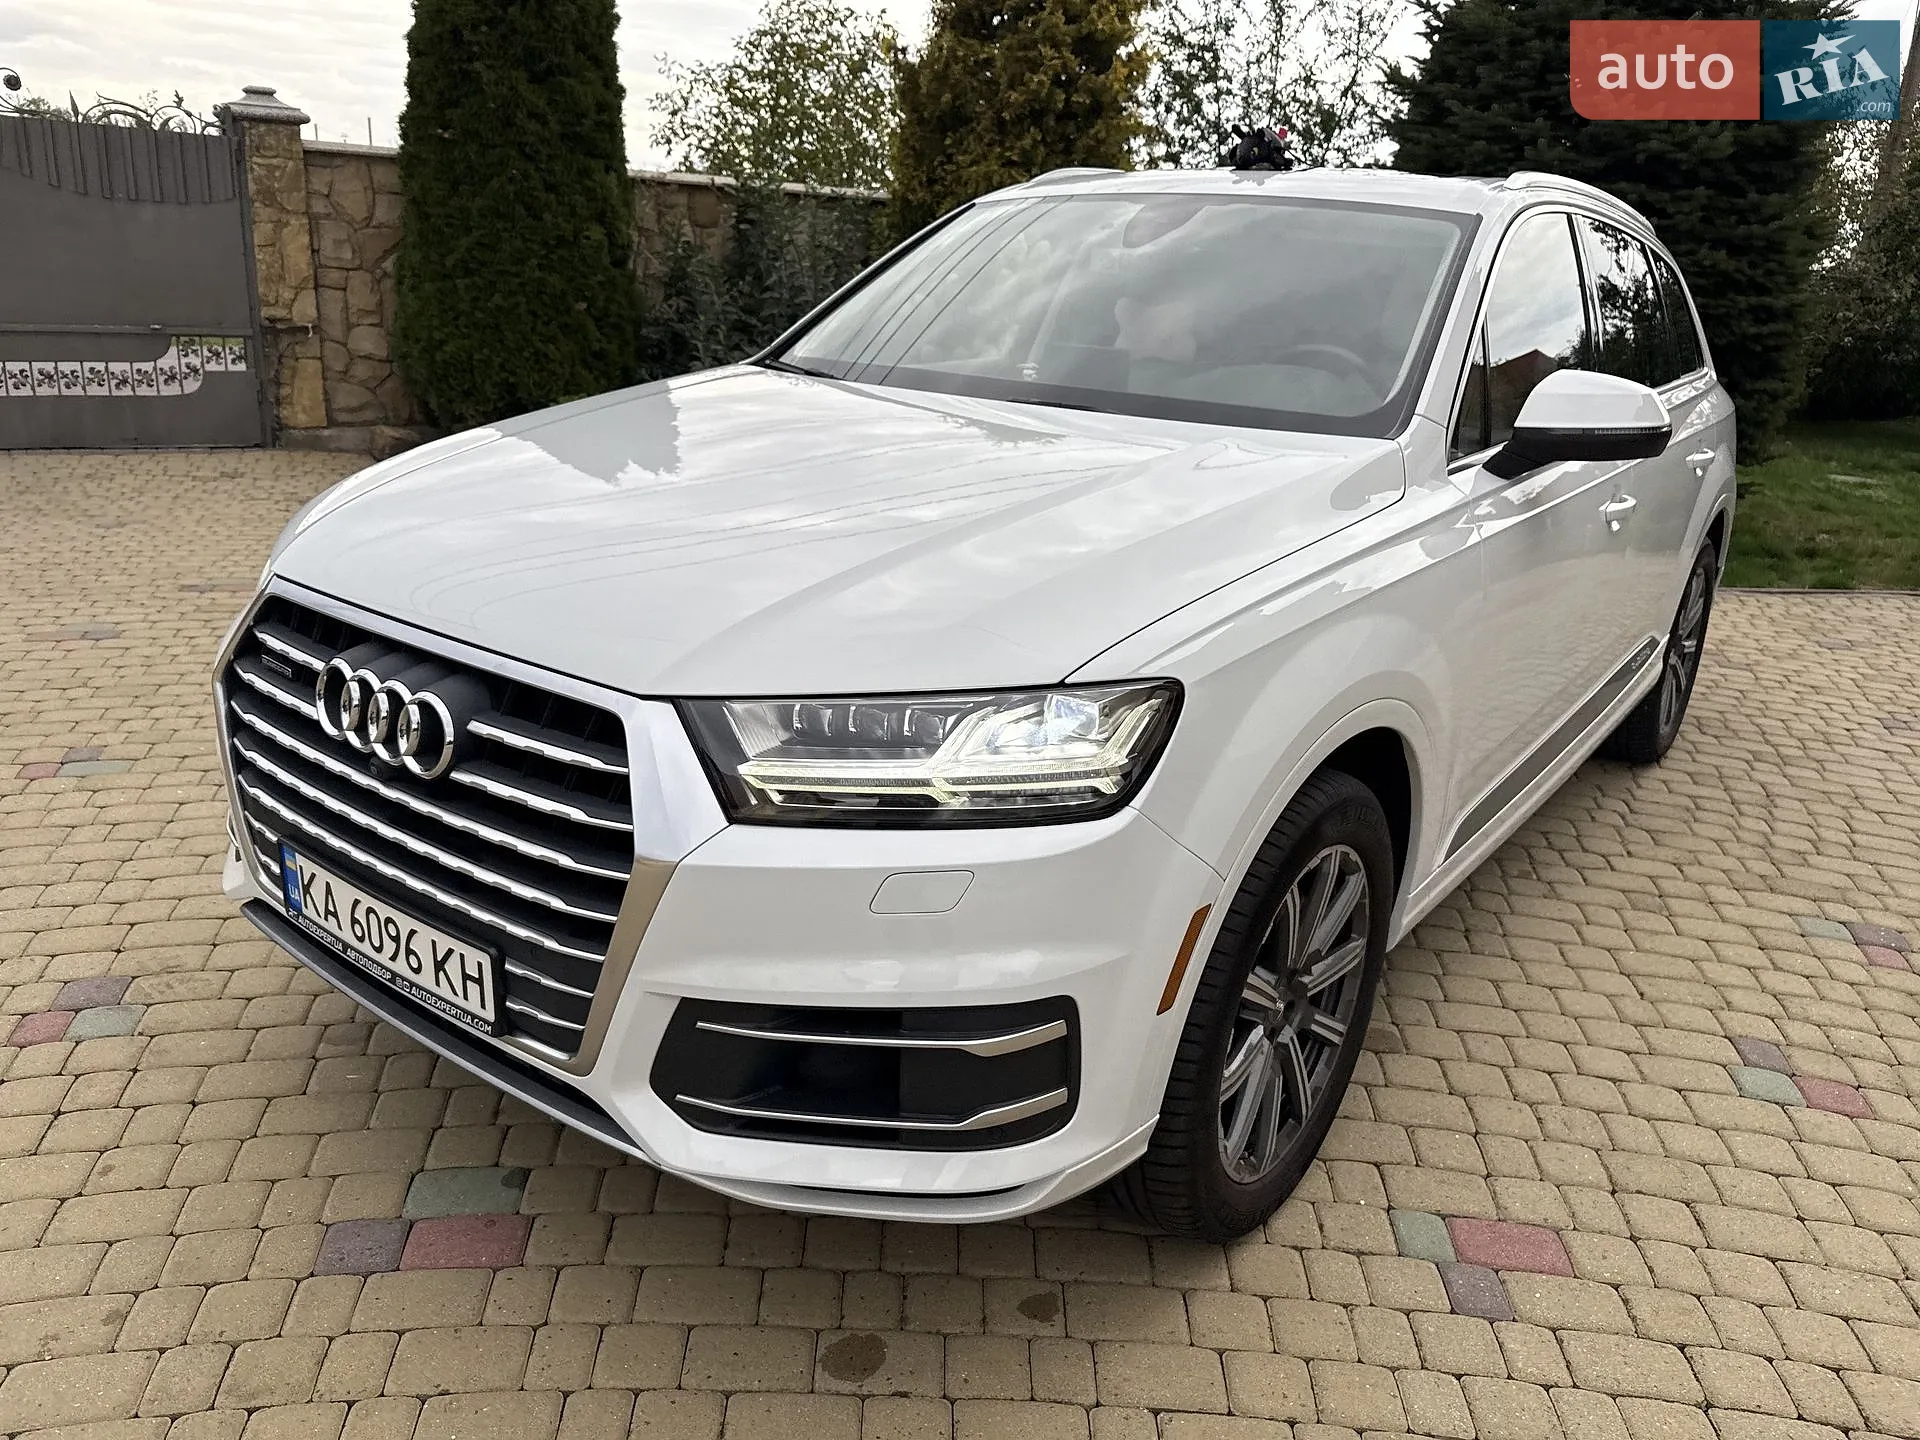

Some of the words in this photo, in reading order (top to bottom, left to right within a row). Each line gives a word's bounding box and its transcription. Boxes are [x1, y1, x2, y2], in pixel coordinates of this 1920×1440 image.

[288, 884, 301, 902] UA
[298, 915, 343, 951] AUTOEXPERTUA
[299, 864, 343, 932] KA
[350, 898, 423, 975] 6096
[431, 938, 487, 1011] KH
[411, 985, 492, 1035] AUTOEXPERTUA.COM
